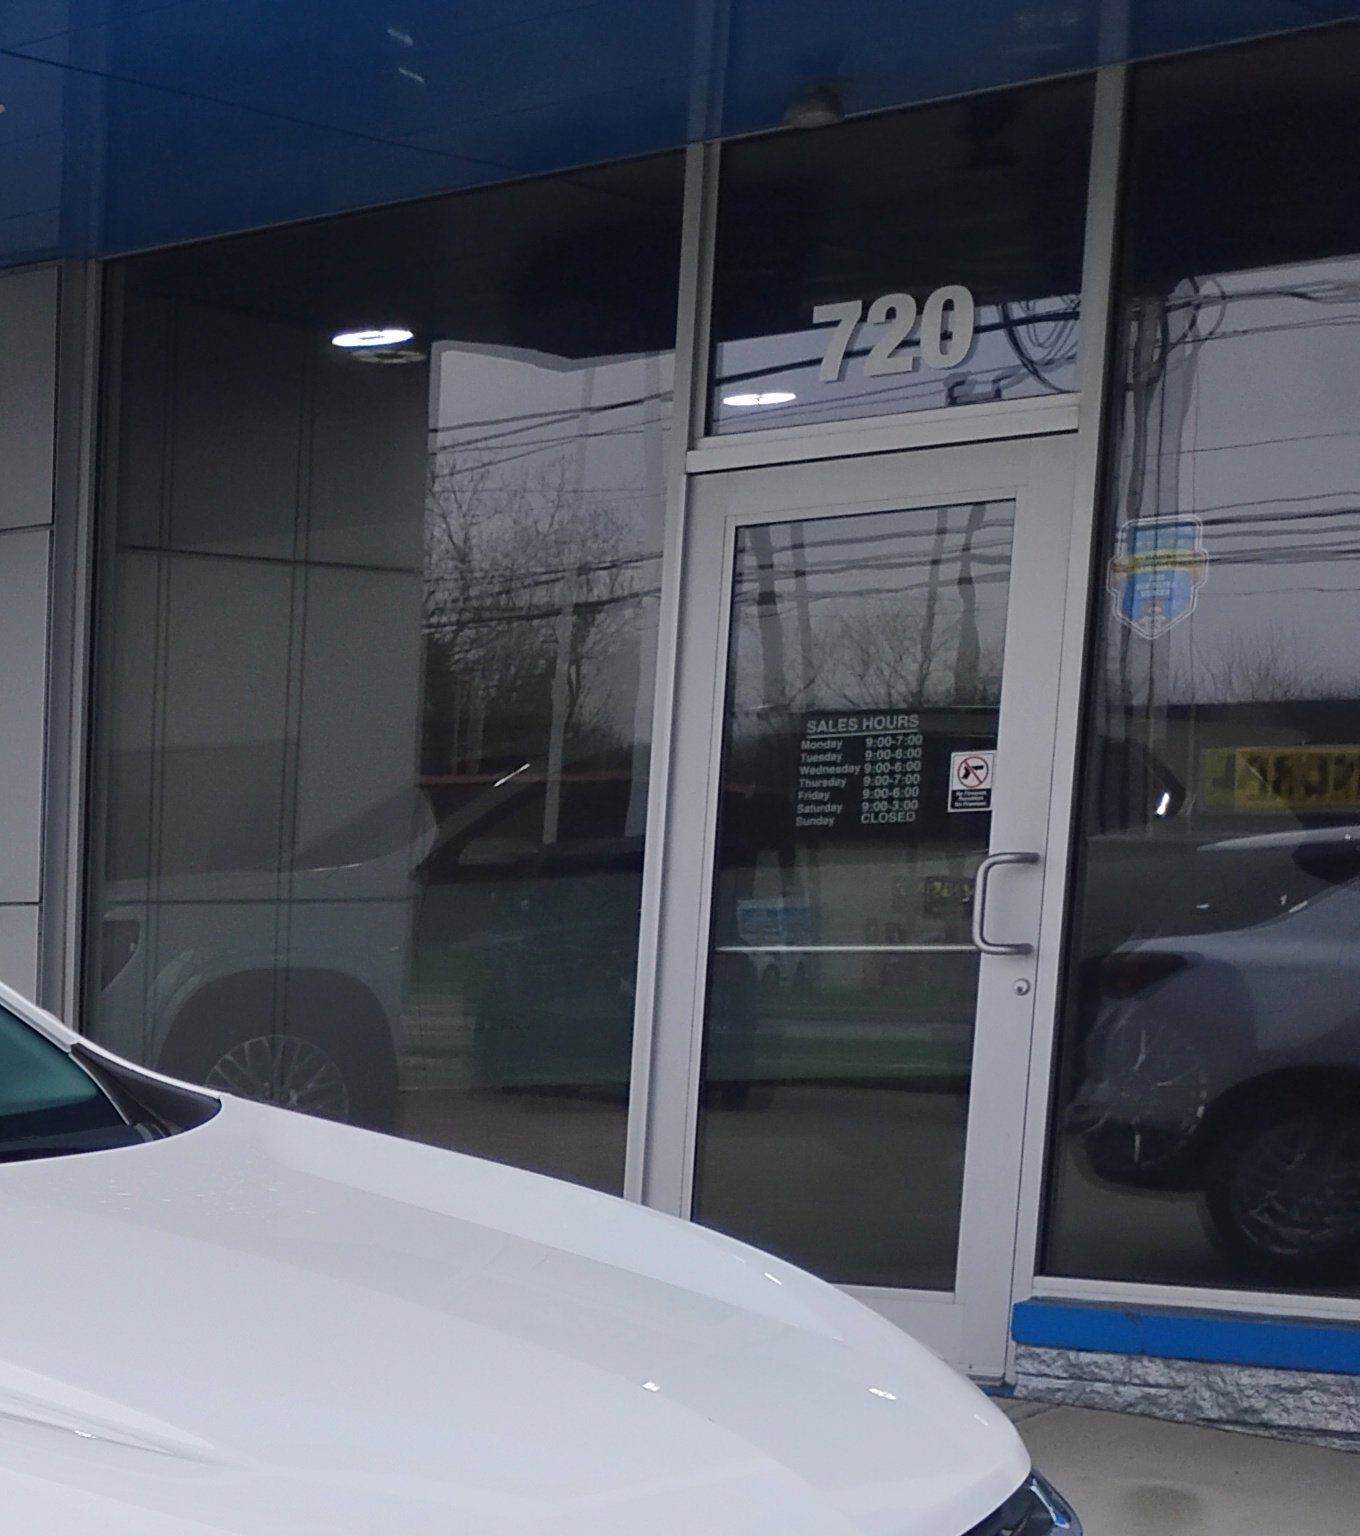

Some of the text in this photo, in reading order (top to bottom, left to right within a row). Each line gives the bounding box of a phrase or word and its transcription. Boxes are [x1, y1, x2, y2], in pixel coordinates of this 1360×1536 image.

[812, 285, 975, 381] 720
[806, 714, 920, 734] SALES HOURS
[801, 735, 923, 751] Monday 9:00-7:00
[800, 748, 922, 764] Tuesday 9:00-6:00
[799, 761, 922, 776] Wednesday 9:00-6:00
[799, 774, 921, 789] Thursday 9:00-7:00
[798, 787, 920, 802] Friday 9:00-6:00
[797, 800, 919, 815] Saturday 9:00-3:00
[795, 811, 917, 828] Sunday CLOSED
